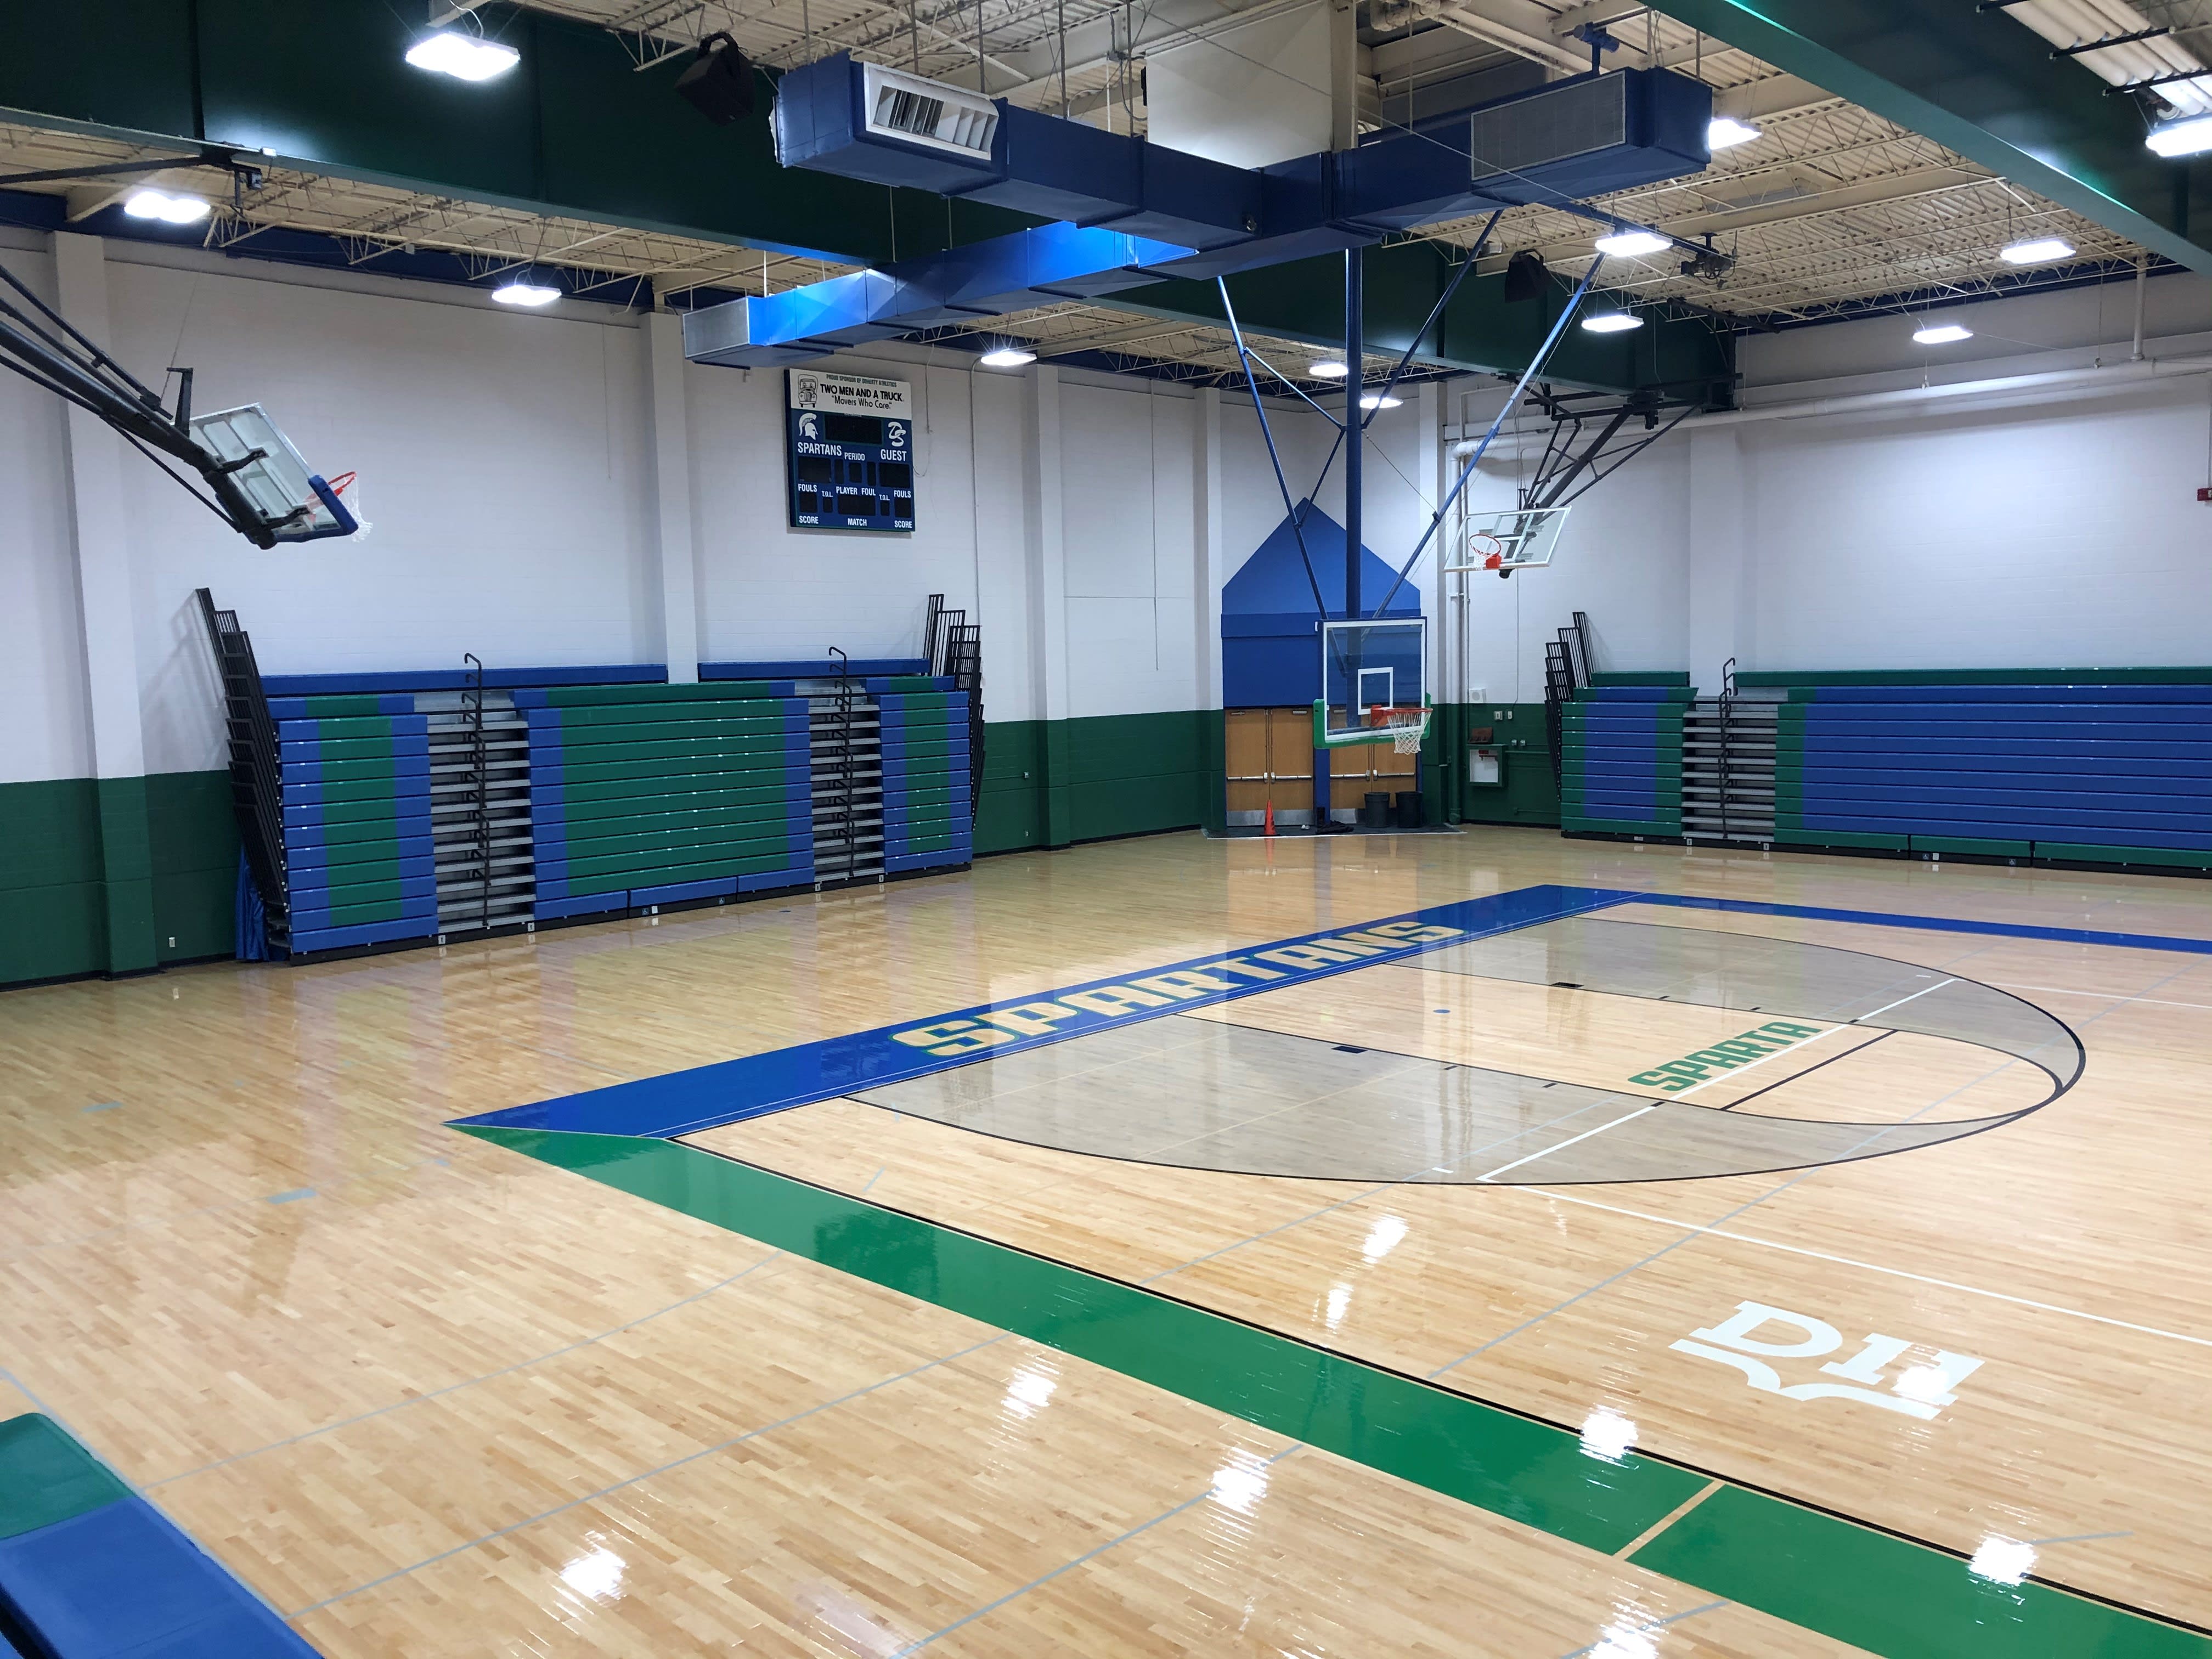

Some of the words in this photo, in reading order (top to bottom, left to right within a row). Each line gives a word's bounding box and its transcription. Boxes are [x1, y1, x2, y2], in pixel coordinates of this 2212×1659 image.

[820, 384, 837, 394] TWO
[839, 386, 854, 396] MEN
[856, 388, 871, 398] AND
[873, 390, 878, 398] A
[858, 398, 873, 408] Who
[798, 442, 842, 456] SPARTANS
[844, 452, 865, 461] PERIOD
[881, 449, 907, 461] GUEST
[798, 483, 817, 492] FOULS
[836, 486, 857, 495] PLAYER
[861, 488, 876, 496] FOUL
[894, 490, 911, 498] FOULS
[799, 516, 819, 524] SCORE
[848, 518, 867, 526] MATCH
[894, 520, 912, 528] SCORE
[889, 921, 1466, 1057] SPARTANS
[1628, 1022, 1823, 1092] SPARTA
